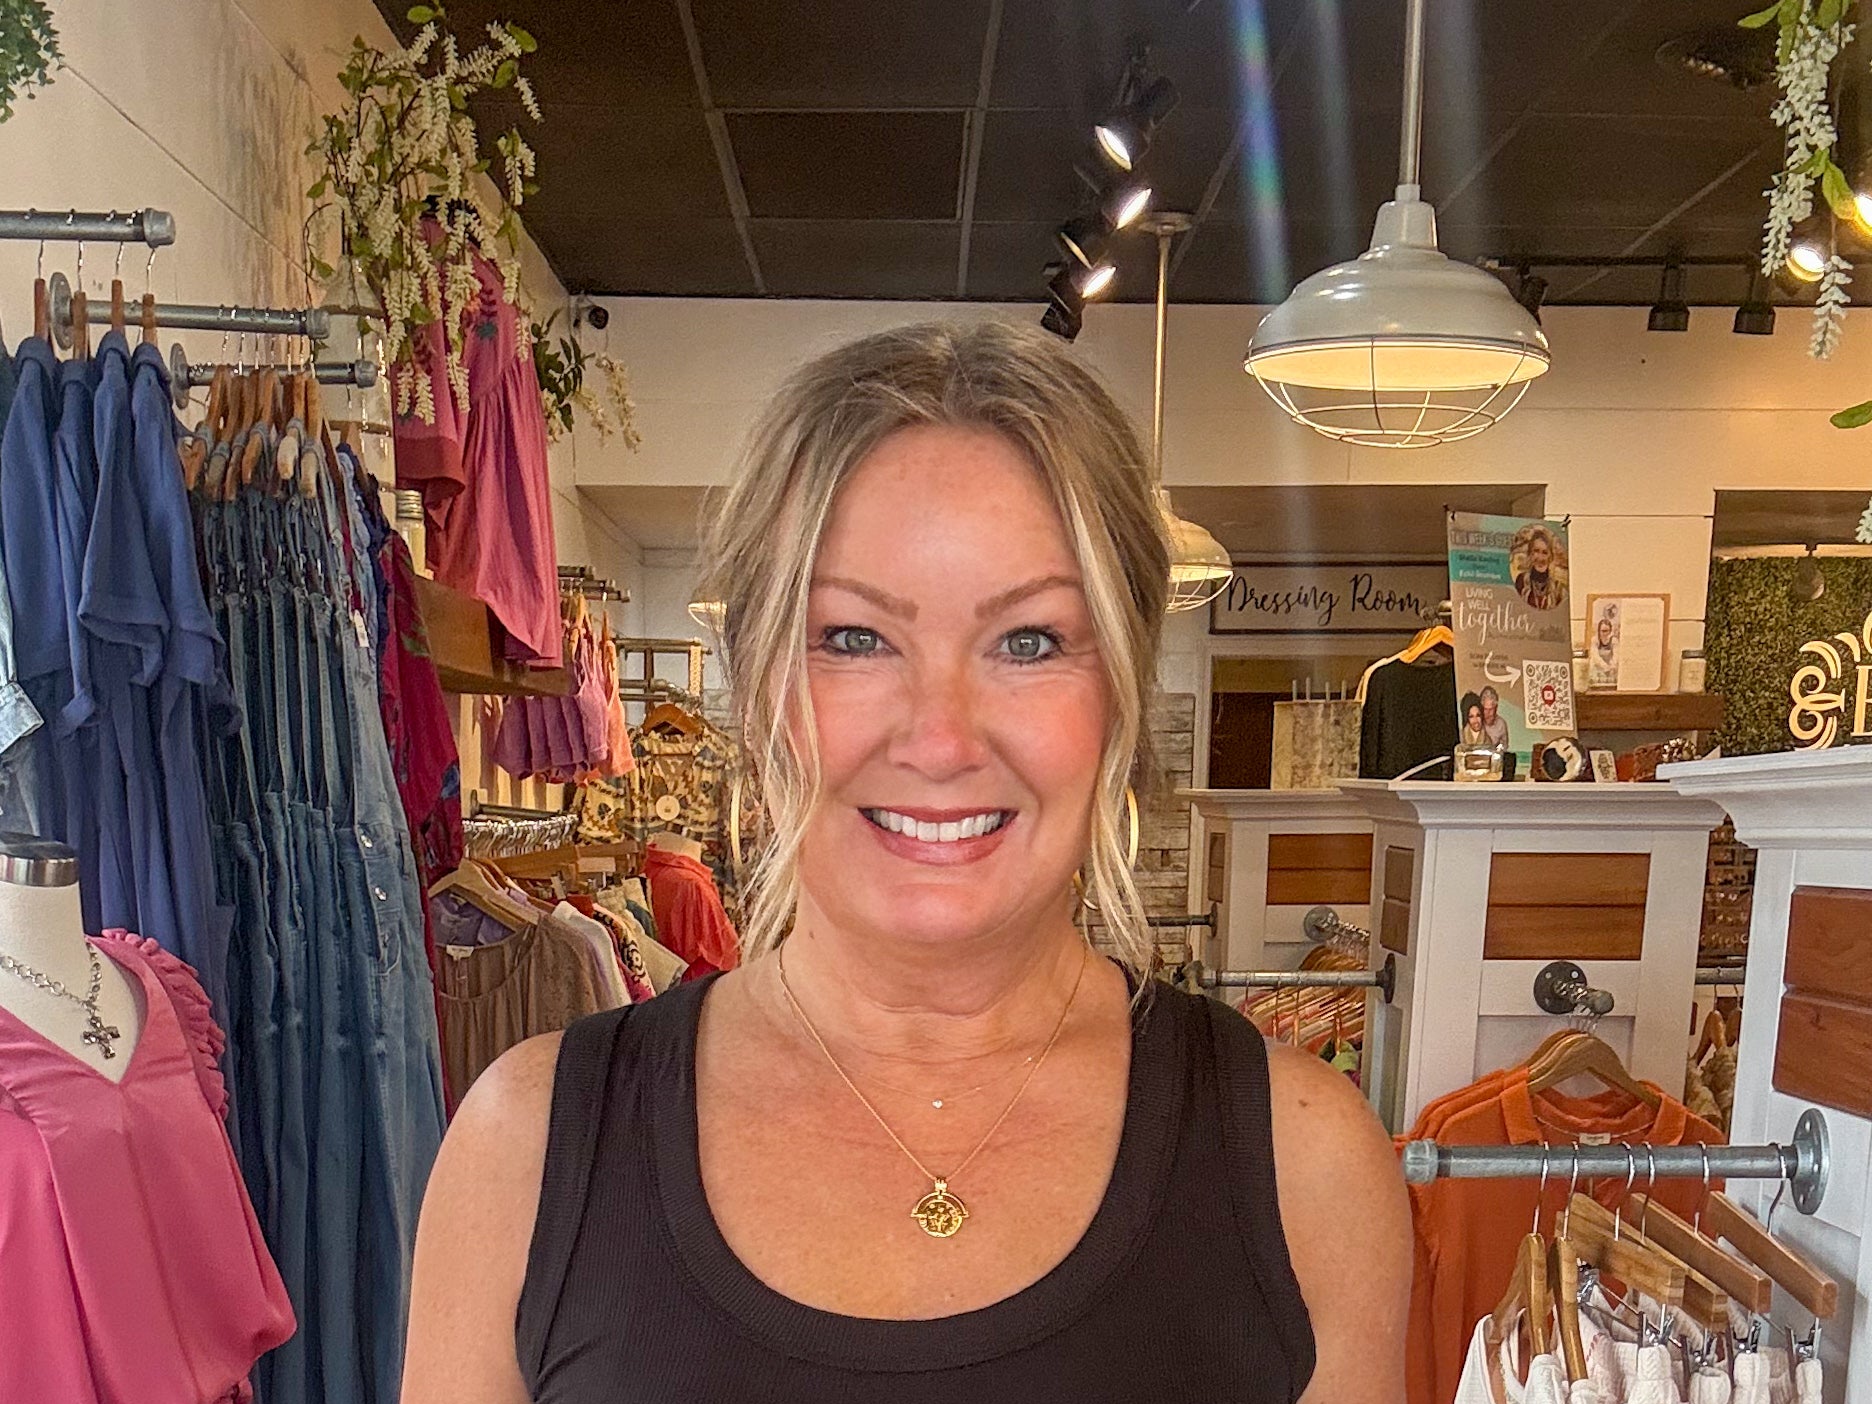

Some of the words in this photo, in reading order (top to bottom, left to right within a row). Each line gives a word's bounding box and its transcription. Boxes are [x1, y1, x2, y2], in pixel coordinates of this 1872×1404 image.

[1227, 575, 1340, 626] Dressing
[1350, 572, 1424, 616] Room
[1465, 587, 1494, 599] LIVING
[1468, 600, 1490, 611] WELL
[1459, 601, 1536, 645] together
